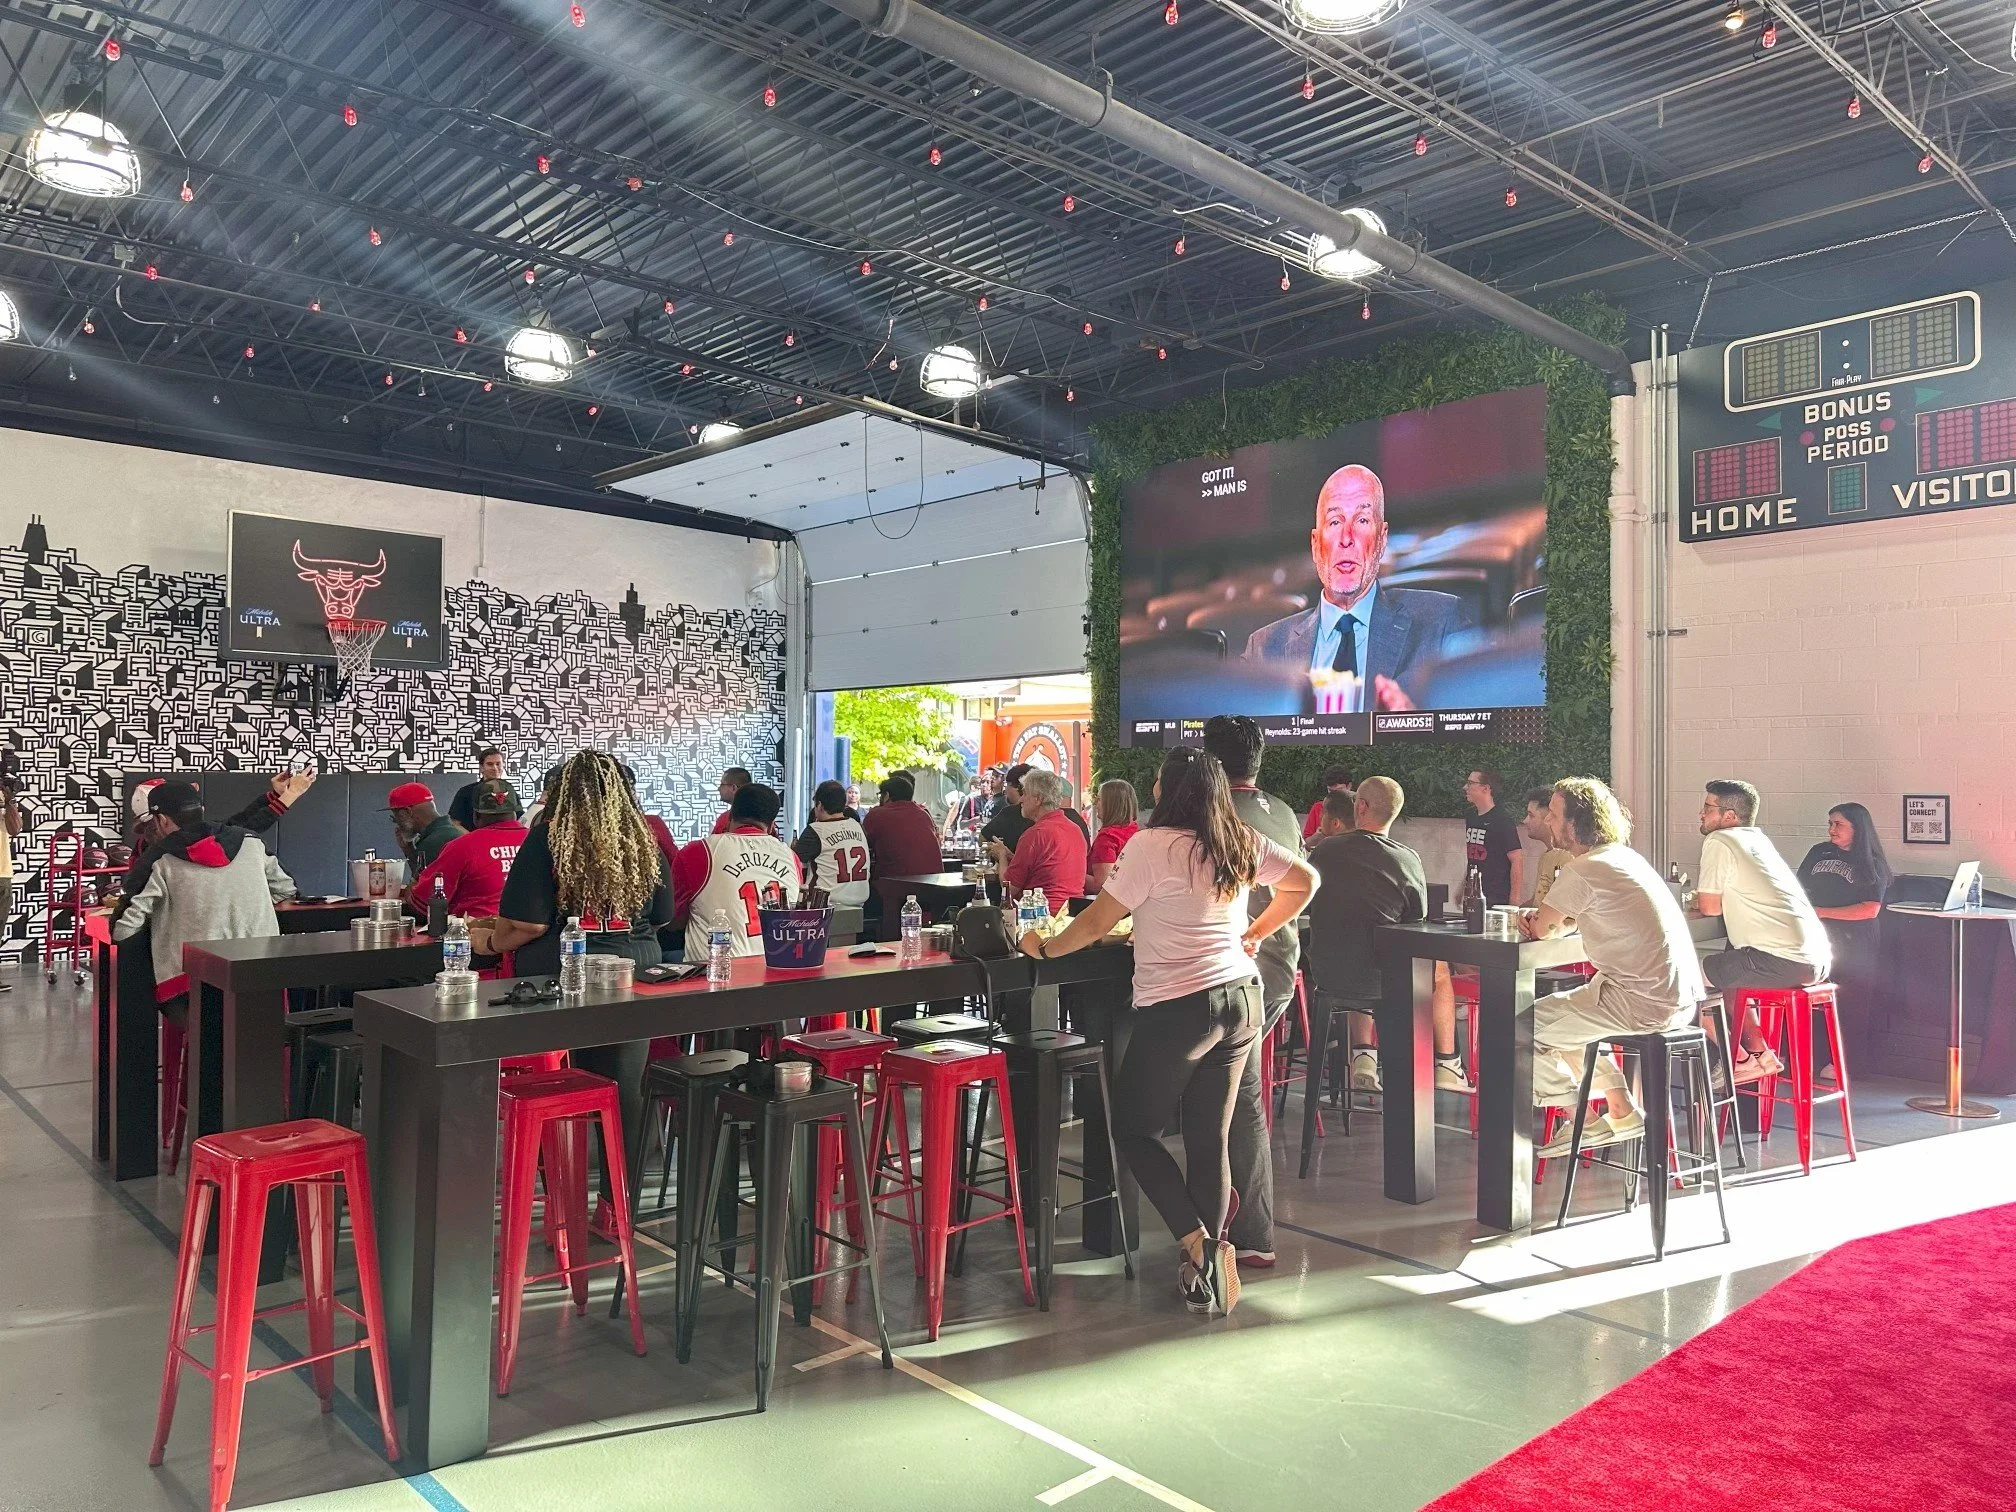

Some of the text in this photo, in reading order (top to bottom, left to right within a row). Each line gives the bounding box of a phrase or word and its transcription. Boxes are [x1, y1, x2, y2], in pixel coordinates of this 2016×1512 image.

[1804, 391, 1891, 424] BONUS
[1824, 420, 1872, 442] POSS
[1807, 435, 1889, 463] PERIOD
[1201, 466, 1234, 483] GOT IT!
[1213, 481, 1235, 497] MAN
[1237, 479, 1247, 493] IS
[1892, 468, 2016, 510] VISITO
[1691, 498, 1797, 535] HOME
[239, 614, 281, 626] ULTRA
[392, 626, 428, 637] ULTRA
[1183, 720, 1204, 729] Pirates
[1300, 717, 1314, 725] Final
[1386, 717, 1424, 728] AWARDS
[1439, 713, 1476, 722] THURSDAY
[1483, 712, 1492, 720] ET
[1135, 722, 1159, 733] ESPN
[1183, 730, 1193, 738] PIT
[1264, 726, 1347, 737] Reynolds: 23-game hit streak
[1466, 827, 1487, 845] SEE
[722, 852, 790, 878] DeROZAN
[834, 846, 868, 883] 12
[772, 928, 826, 941] ULTRA
